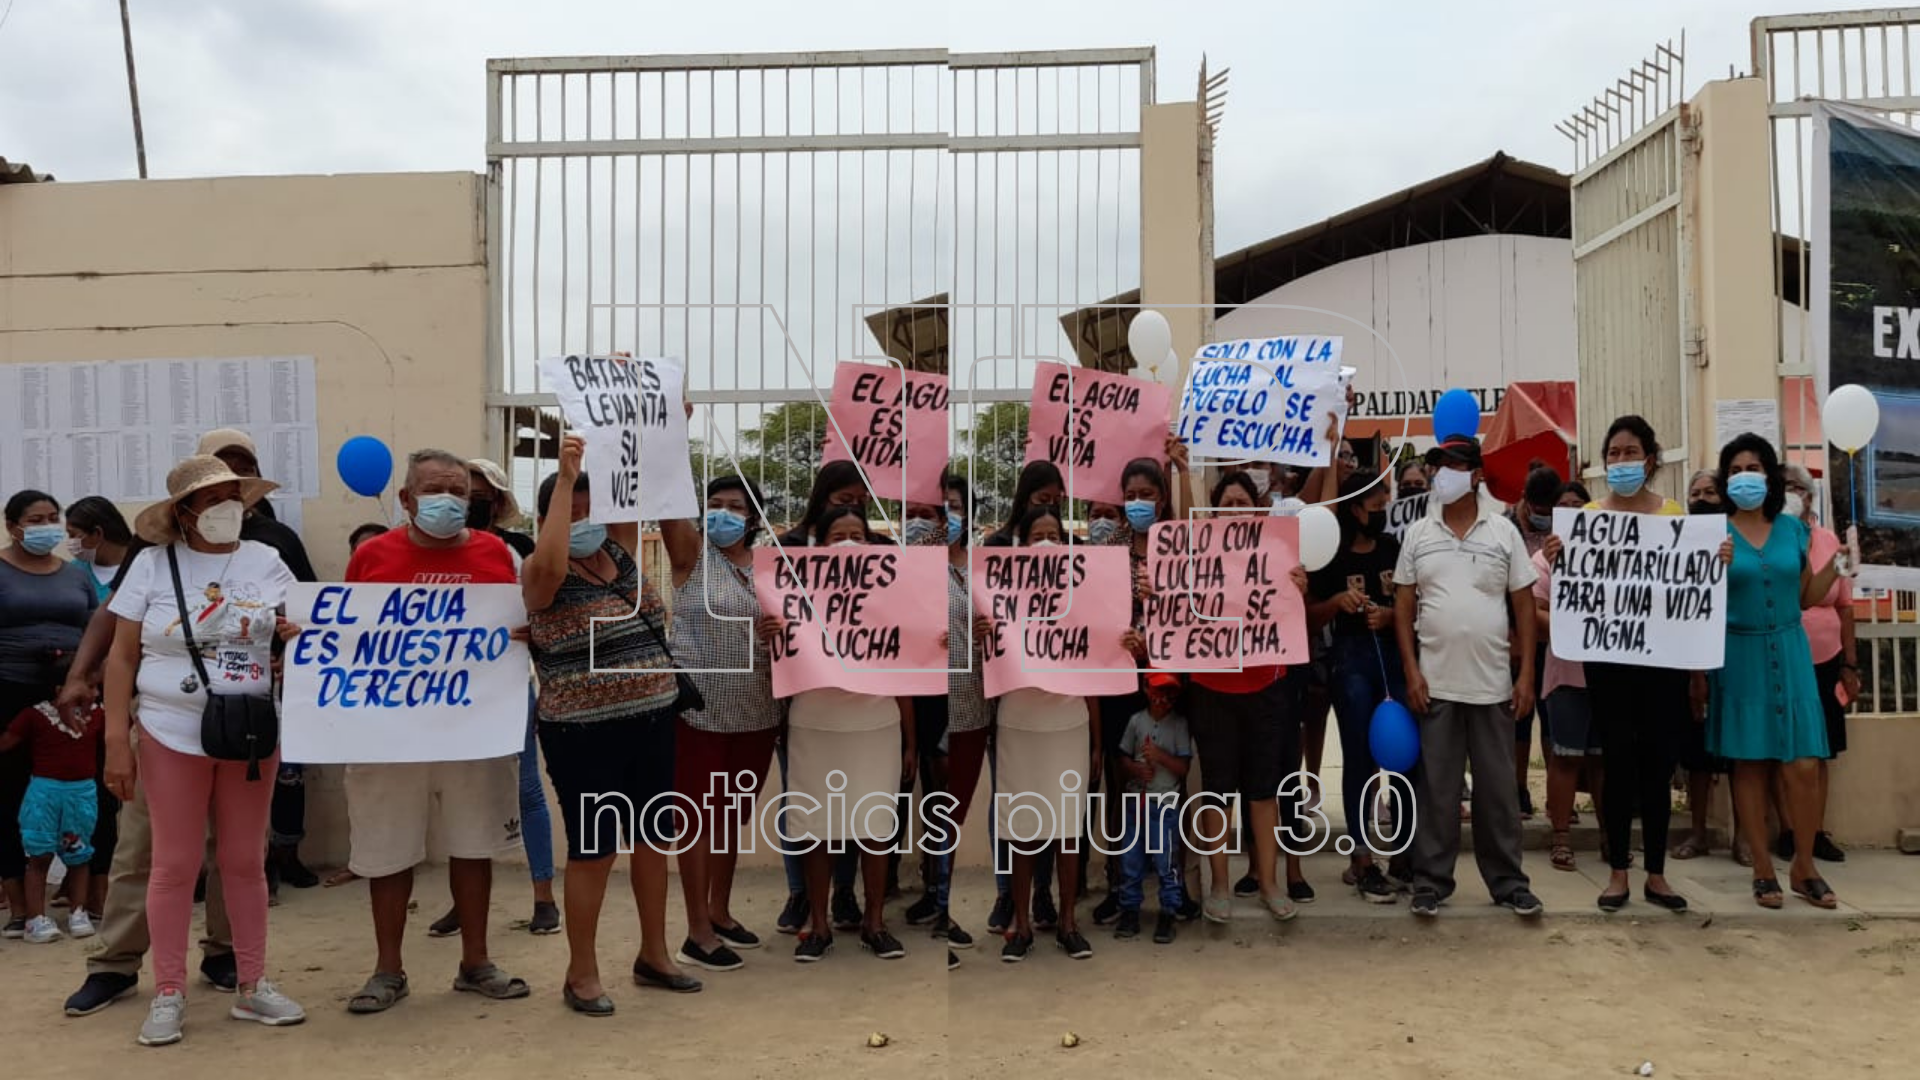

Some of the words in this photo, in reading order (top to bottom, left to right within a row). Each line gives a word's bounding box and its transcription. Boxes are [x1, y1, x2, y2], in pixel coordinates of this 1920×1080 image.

[1200, 341, 1250, 365] SOLO
[1257, 339, 1298, 360] CON
[1304, 339, 1332, 363] LA
[564, 355, 660, 391] BATANES
[1192, 364, 1252, 388] LUCHA
[1270, 364, 1295, 388] AL
[585, 392, 667, 428] LEVANTA
[851, 373, 886, 404] EL
[892, 381, 948, 411] AGU
[1049, 373, 1076, 404] EL
[1081, 381, 1140, 414] AGUA
[1183, 387, 1268, 416] PUEBLO
[1285, 392, 1316, 421] SE
[869, 407, 904, 438] ES
[1063, 407, 1093, 438] ES
[1178, 415, 1209, 444] LE
[620, 430, 643, 467] SU
[852, 434, 908, 468] VIDA
[1049, 434, 1095, 468] VIDA
[1391, 494, 1429, 528] CON
[1569, 512, 1640, 546] AGUA
[1156, 523, 1212, 556] SOLO
[1222, 520, 1263, 552] CON
[774, 553, 897, 590] BATANES
[984, 554, 1086, 590] BATANES
[1154, 555, 1225, 592] LUCHA
[1245, 552, 1272, 585] AL
[310, 586, 358, 625] EL
[378, 587, 466, 626] AGUA
[783, 594, 814, 622] EN
[992, 593, 1018, 622] EN
[1146, 592, 1225, 627] PUEBLO
[1245, 588, 1277, 620] SE
[1556, 580, 1605, 614] PARA
[1613, 584, 1653, 618] UNA
[1666, 587, 1713, 621] VIDA
[293, 629, 339, 665] ES
[352, 627, 511, 667] NUESTRO
[771, 621, 801, 662] DE
[822, 625, 901, 661] LUCHA
[983, 621, 1008, 662] DE
[1024, 625, 1089, 661] LUCHA
[1148, 631, 1176, 660] LE
[317, 667, 472, 708] DERECHO.
